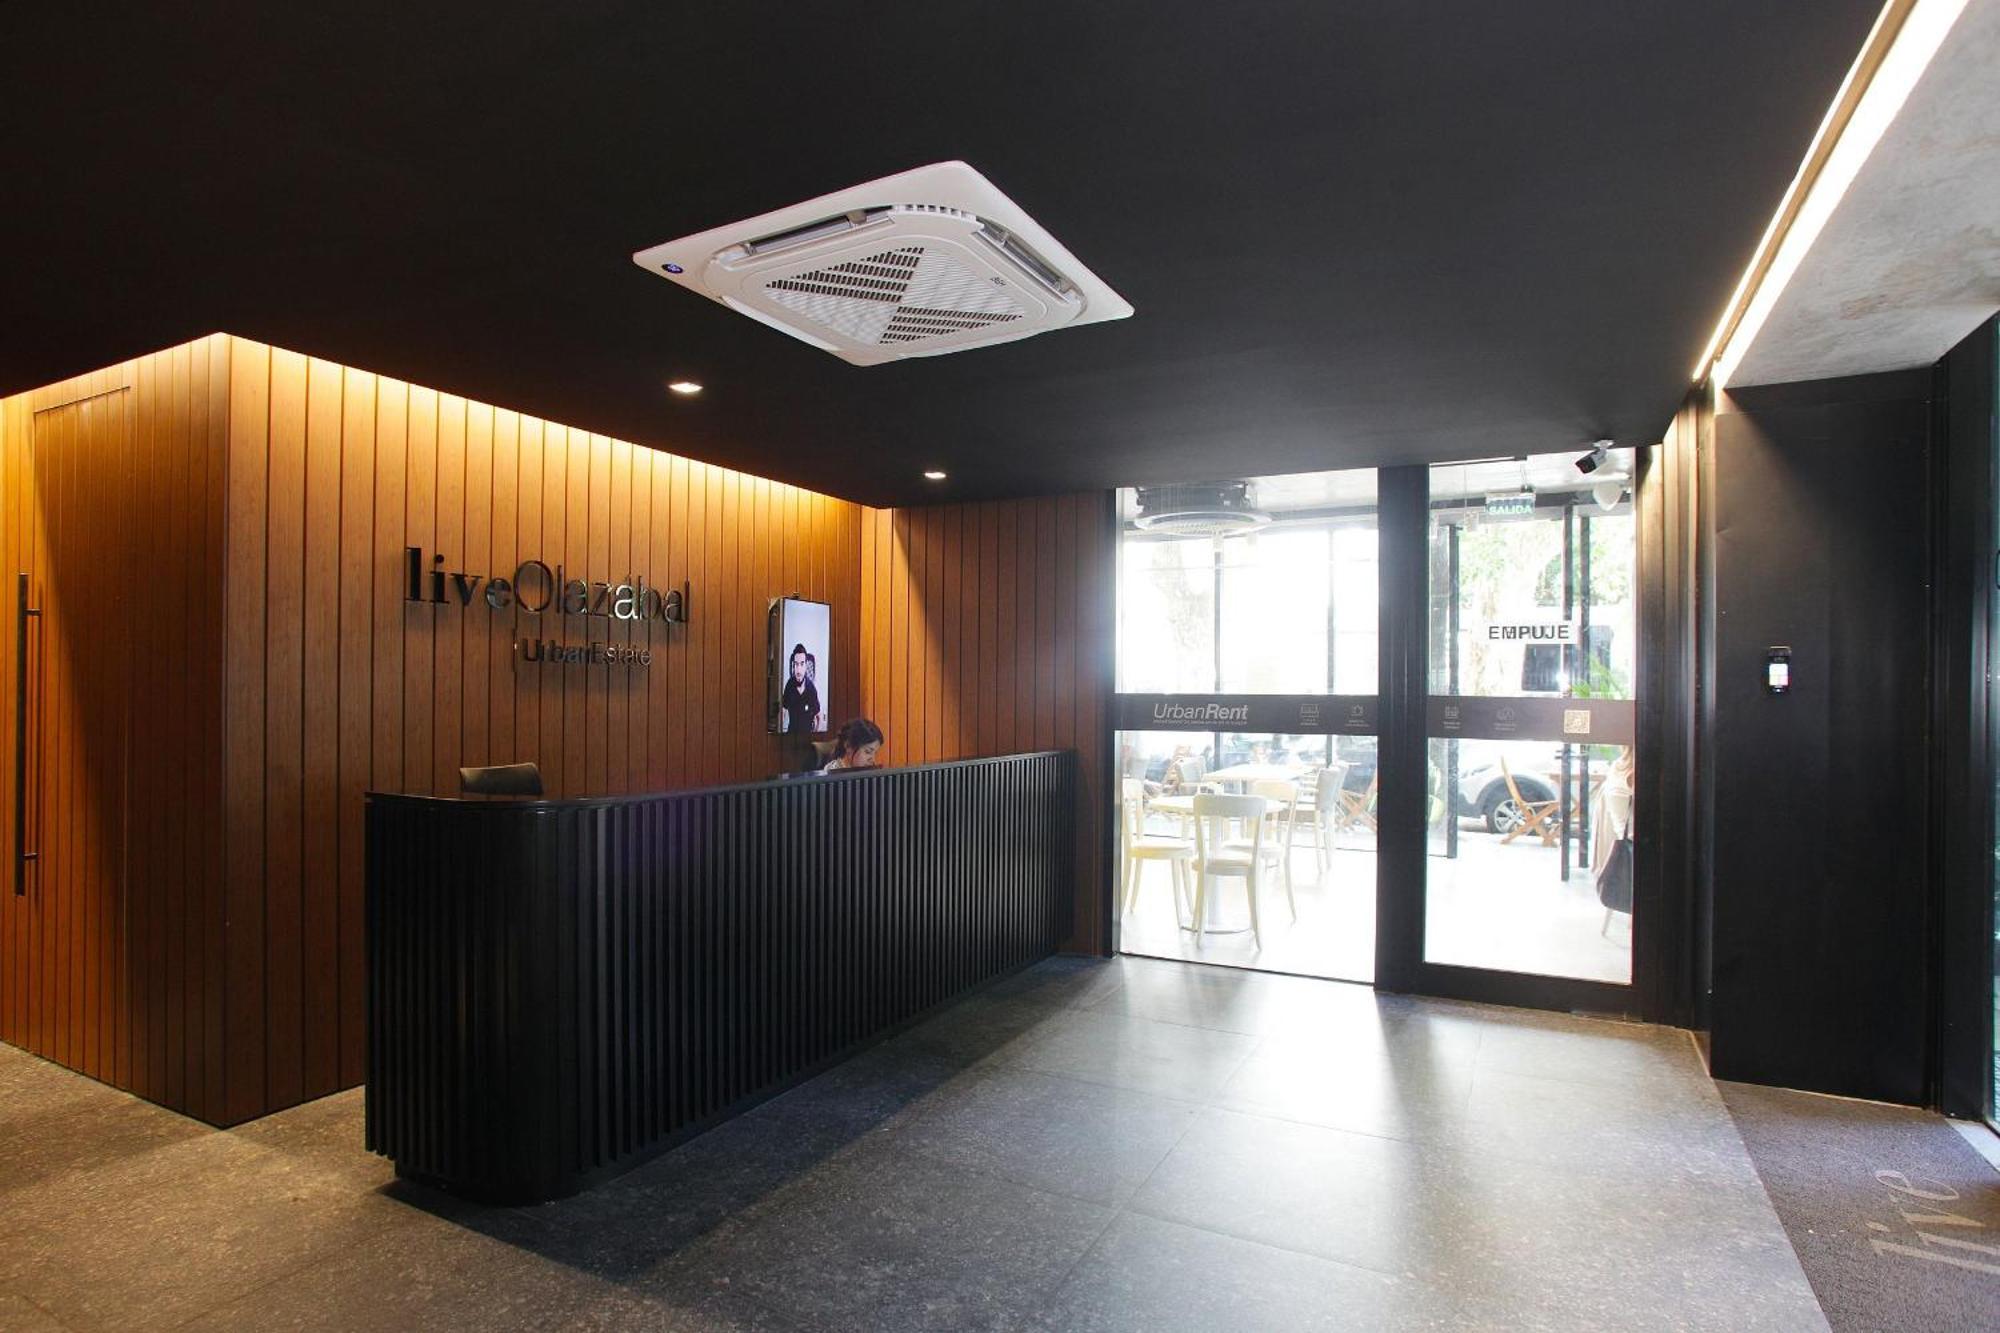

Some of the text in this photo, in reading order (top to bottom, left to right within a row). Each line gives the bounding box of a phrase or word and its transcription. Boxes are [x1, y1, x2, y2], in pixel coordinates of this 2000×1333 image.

[1489, 504, 1533, 514] SALIDA
[1488, 624, 1569, 639] EMPUJE
[522, 637, 652, 666] UrbanEstate
[1154, 702, 1249, 720] UrbanRent
